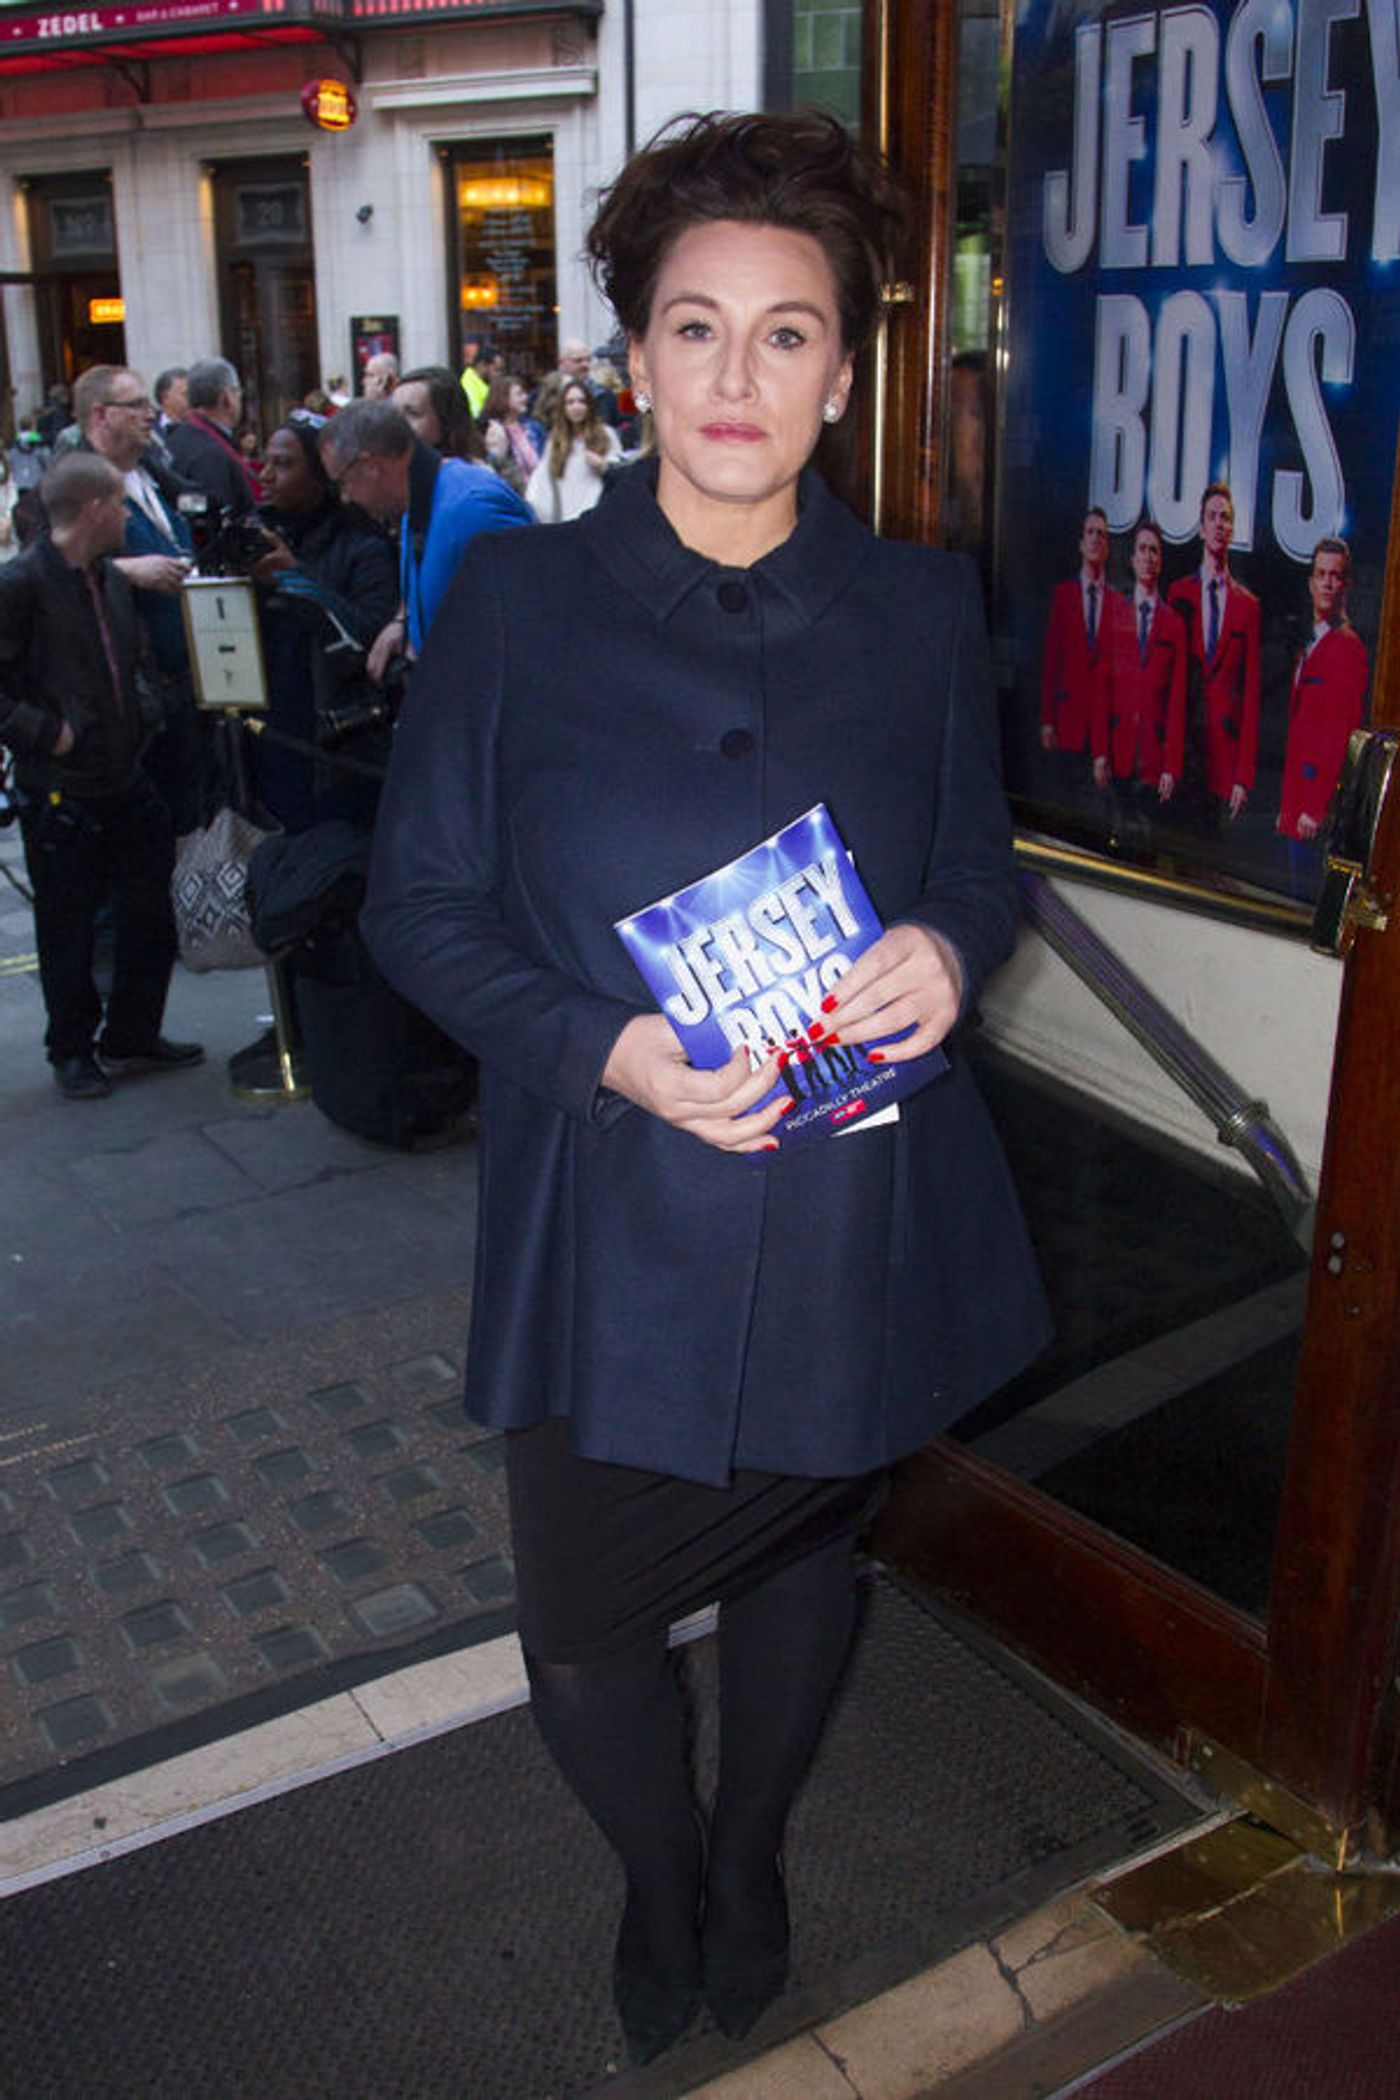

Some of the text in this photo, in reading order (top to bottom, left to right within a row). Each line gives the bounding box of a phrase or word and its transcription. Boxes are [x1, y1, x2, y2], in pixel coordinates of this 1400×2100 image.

[1089, 288, 1355, 563] BOYS
[667, 851, 860, 1026] JERSEY
[785, 1094, 848, 1130] PICCADILLY
[849, 1066, 896, 1098] THEATRE
